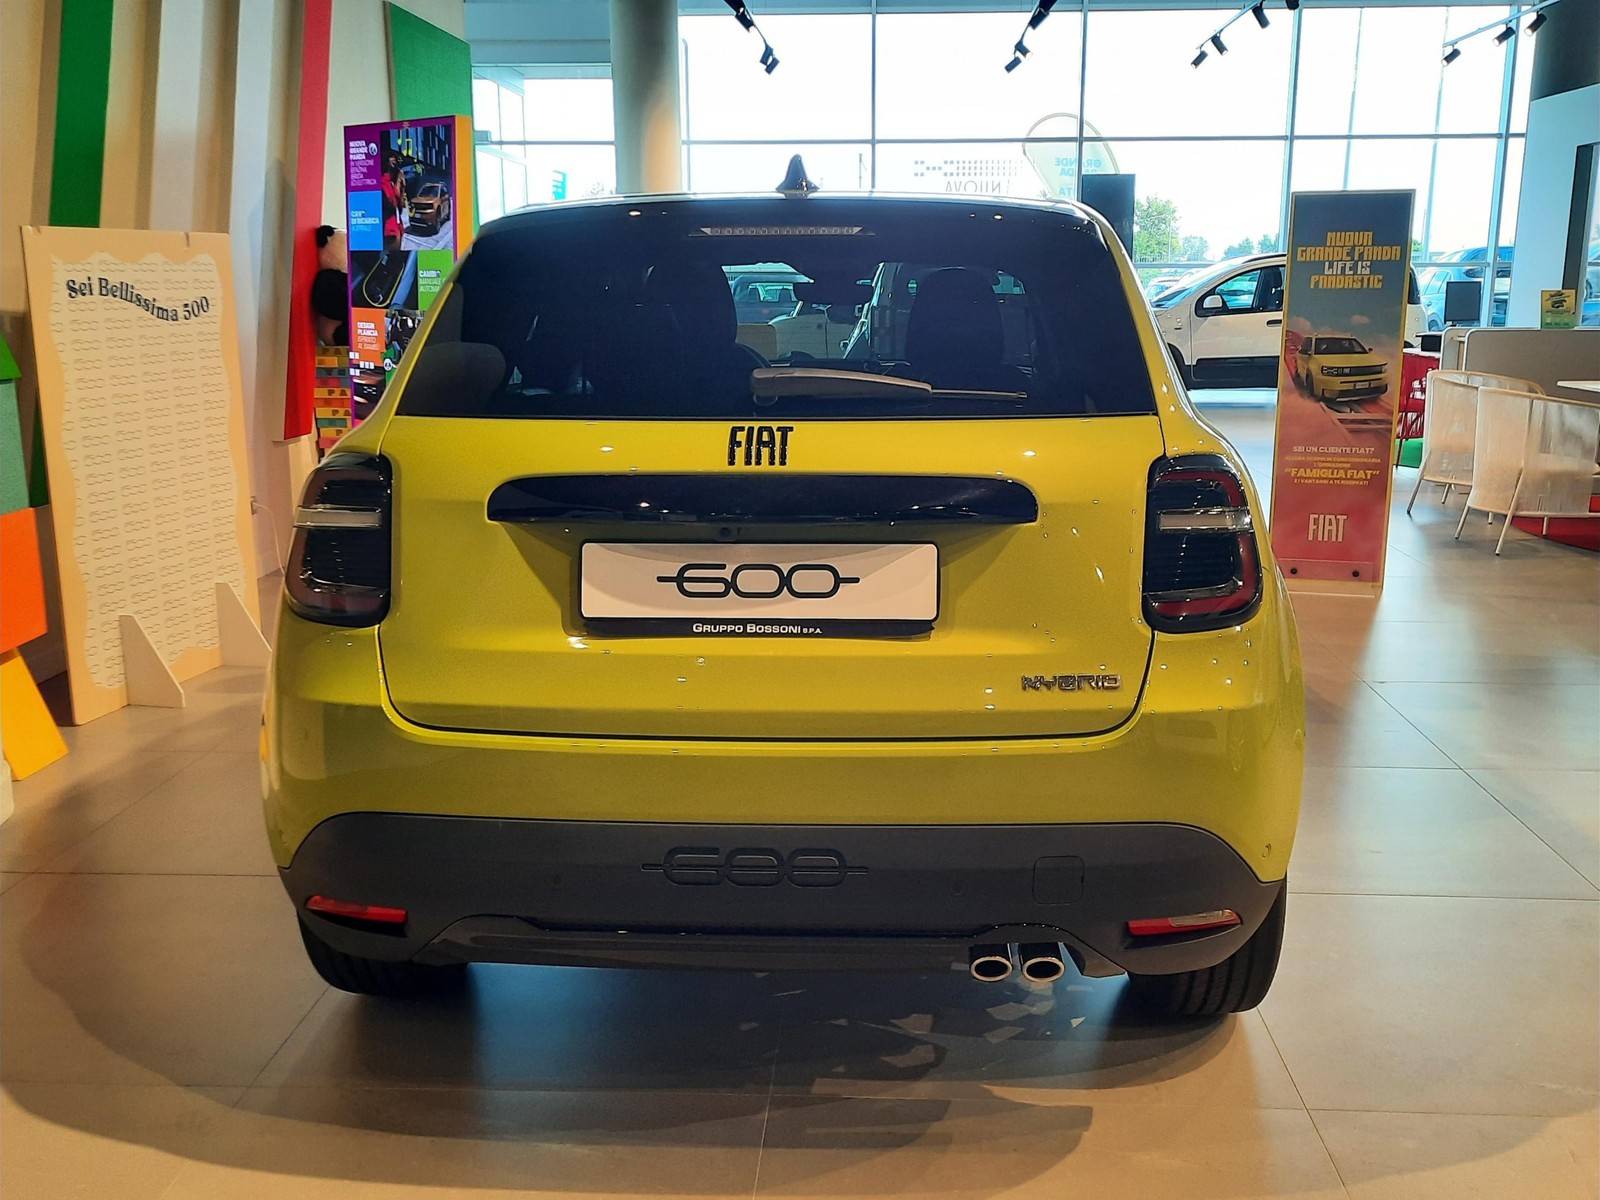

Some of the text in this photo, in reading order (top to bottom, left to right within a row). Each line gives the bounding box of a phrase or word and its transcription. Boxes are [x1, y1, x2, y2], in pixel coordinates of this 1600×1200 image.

[1326, 232, 1373, 246] NUOVA
[1297, 245, 1401, 261] GRANDE PANDA
[1324, 261, 1371, 275] LIFE IS
[1310, 275, 1383, 289] PANDASTIC
[65, 276, 210, 322] Sei Bellissima 500
[727, 425, 794, 467] FIAT
[1307, 514, 1348, 542] FIAT
[656, 563, 860, 600] 600
[692, 623, 744, 633] GRUPPO
[746, 623, 801, 634] BOSSONI
[1021, 672, 1121, 691] HYBRID
[641, 846, 869, 889] 600
